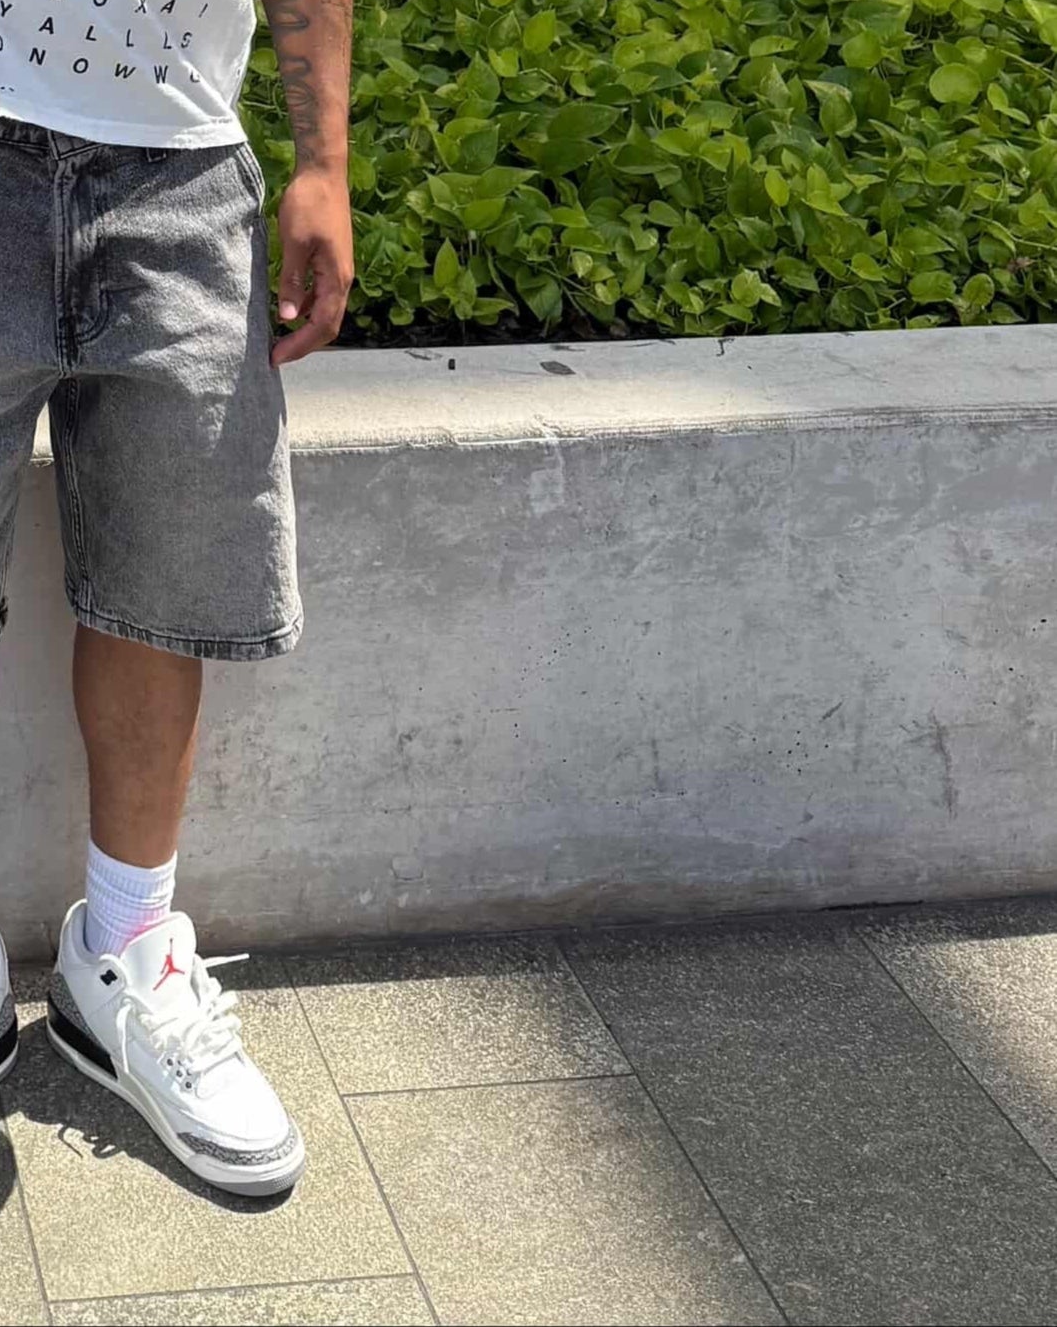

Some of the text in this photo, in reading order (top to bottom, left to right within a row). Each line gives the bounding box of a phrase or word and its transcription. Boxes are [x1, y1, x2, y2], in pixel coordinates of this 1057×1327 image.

[160, 0, 175, 13] A
[0, 0, 12, 17] Y
[39, 17, 54, 34] A
[86, 26, 96, 41] L
[126, 29, 134, 47] L
[163, 32, 172, 49] L
[29, 48, 46, 65] N
[73, 58, 88, 73] O
[115, 63, 136, 79] W
[154, 65, 168, 83] W
